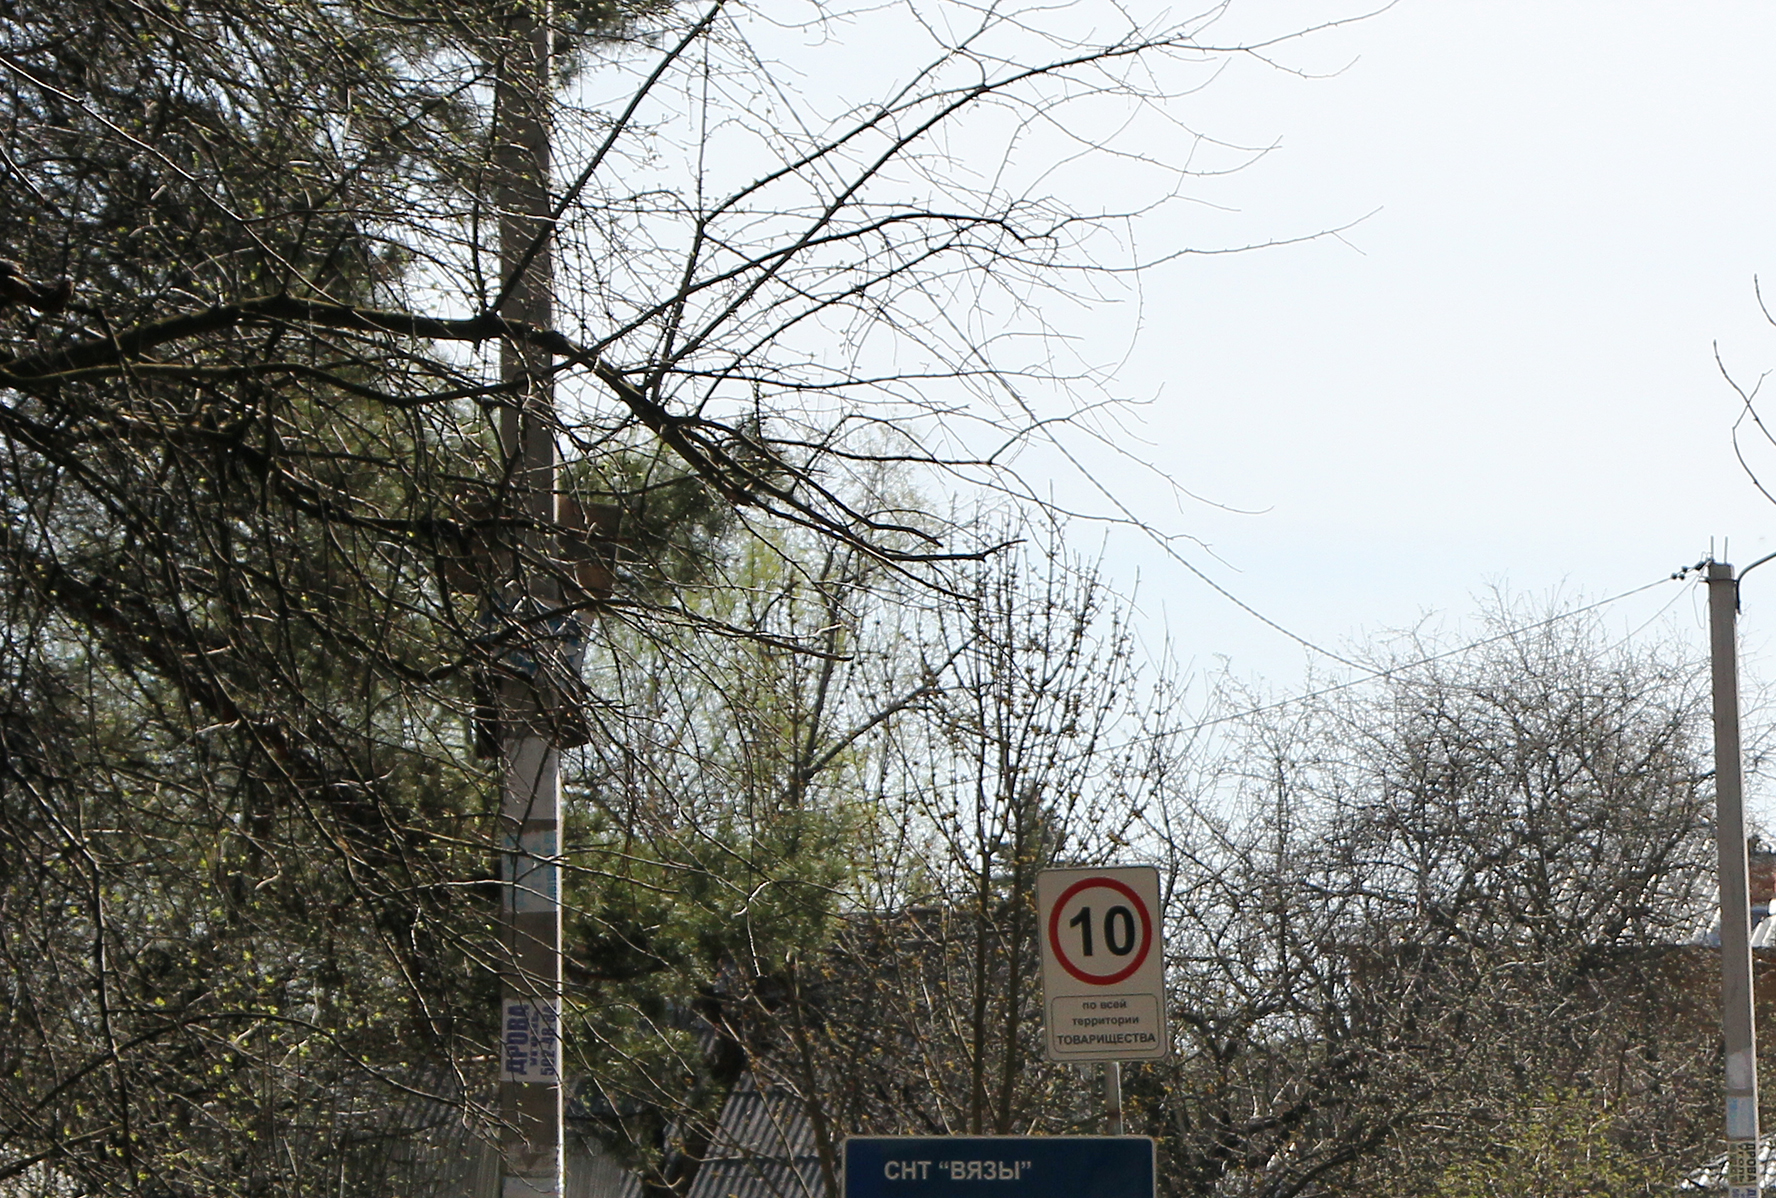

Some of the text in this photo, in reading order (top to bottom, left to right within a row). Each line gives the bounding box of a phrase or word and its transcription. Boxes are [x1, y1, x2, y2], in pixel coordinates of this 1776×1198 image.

[1069, 905, 1136, 957] 10
[1082, 999, 1127, 1010] по всей
[1072, 1015, 1139, 1028] территории
[506, 1004, 529, 1076] ДРОВА
[1057, 1033, 1156, 1046] ТОВАРИЩЕСТВА
[884, 1160, 1032, 1180] СНТ “ВЯЗЫ”
